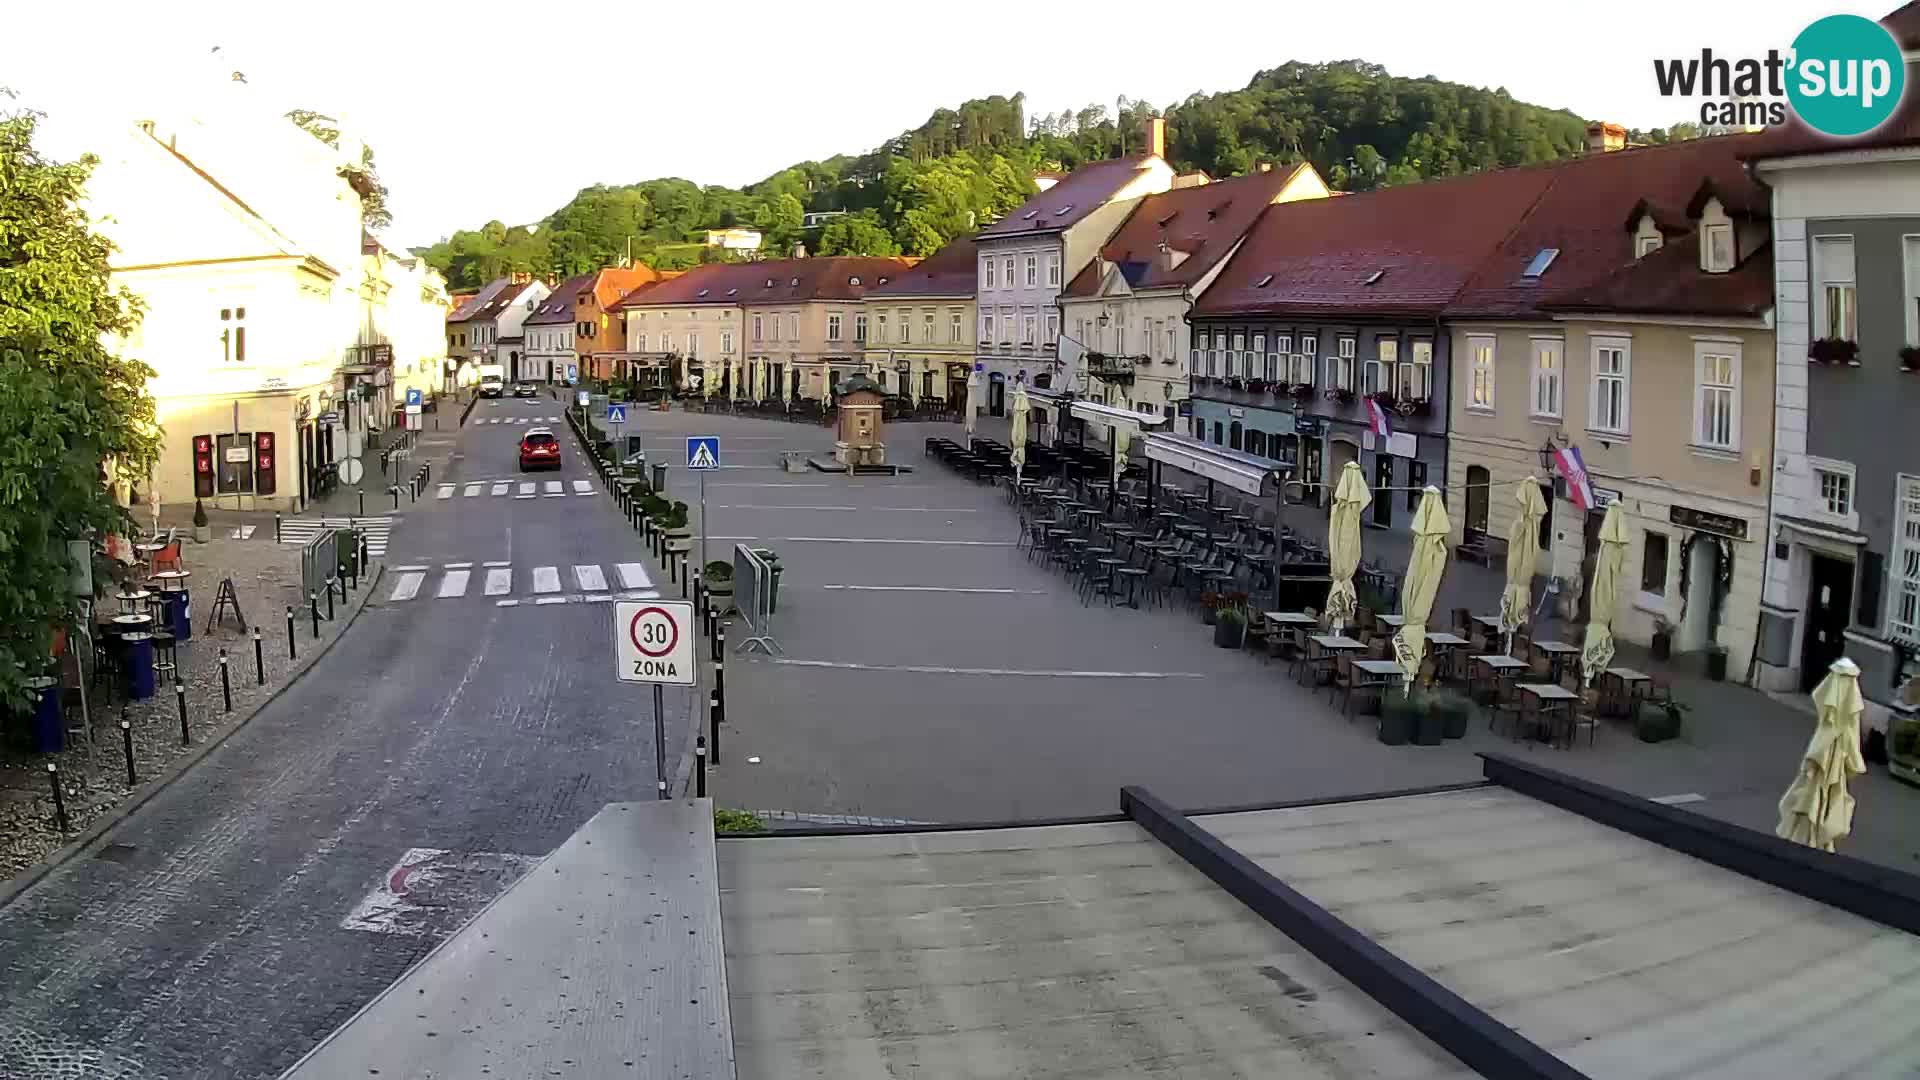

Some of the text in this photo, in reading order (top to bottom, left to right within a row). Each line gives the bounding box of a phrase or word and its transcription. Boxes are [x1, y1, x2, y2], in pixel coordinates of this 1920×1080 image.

[409, 391, 418, 403] P
[643, 622, 667, 644] 30
[633, 660, 678, 677] ZONA
